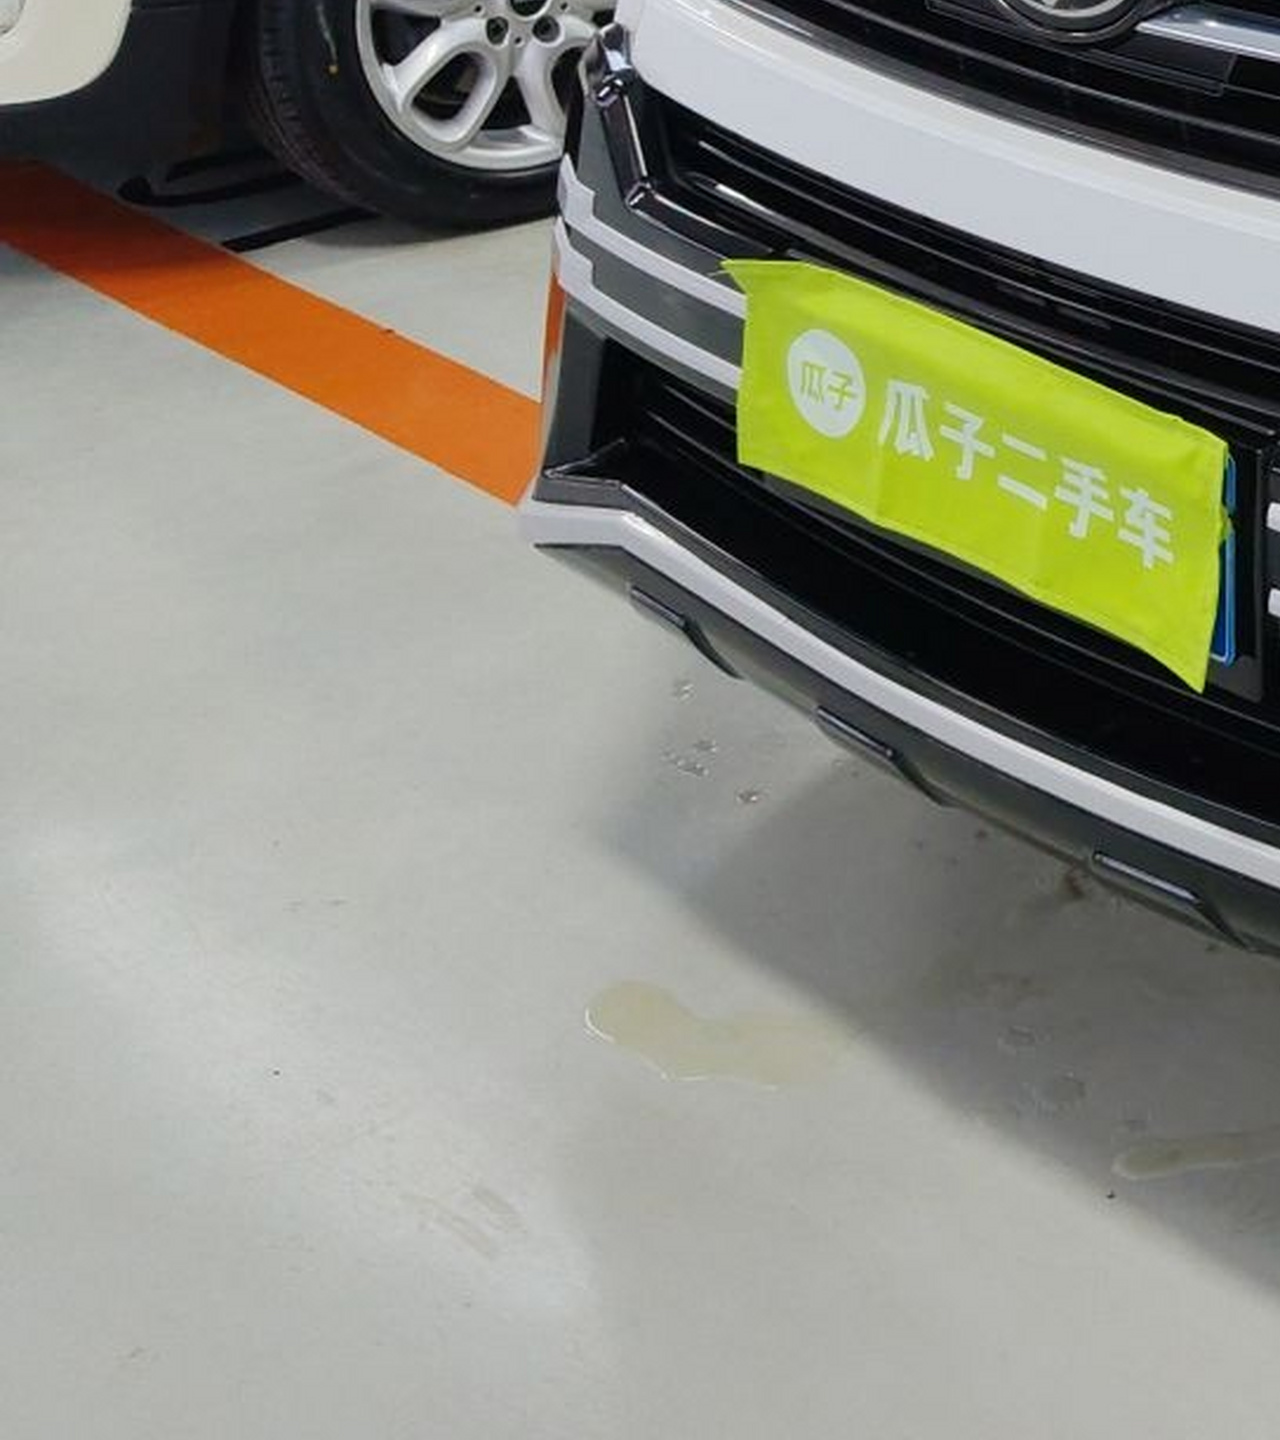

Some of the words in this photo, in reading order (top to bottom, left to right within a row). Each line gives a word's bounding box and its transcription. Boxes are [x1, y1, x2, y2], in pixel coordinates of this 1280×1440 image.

[800, 360, 858, 412] 瓜子
[879, 380, 1174, 569] 瓜子二手车
